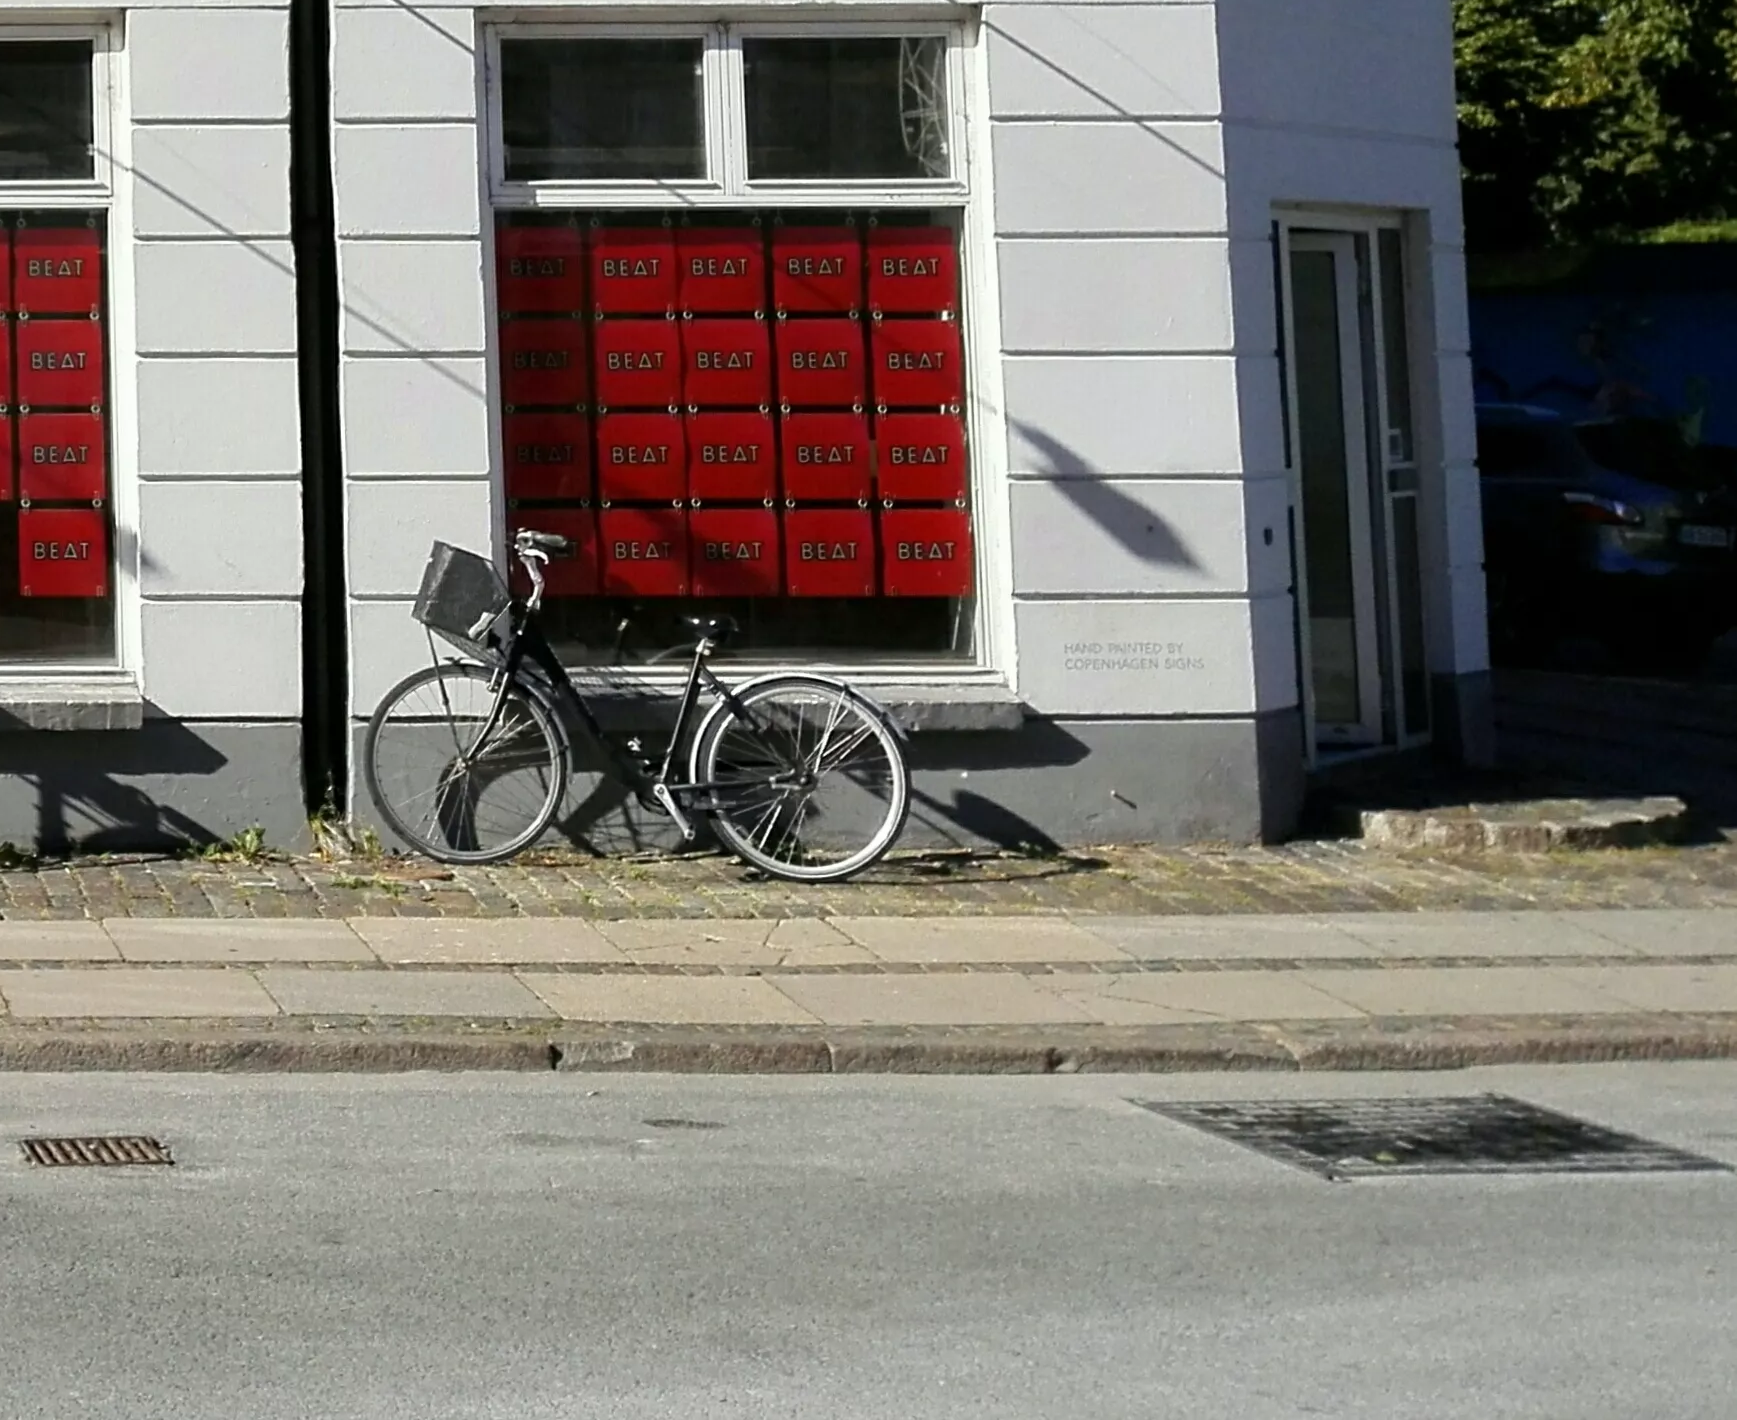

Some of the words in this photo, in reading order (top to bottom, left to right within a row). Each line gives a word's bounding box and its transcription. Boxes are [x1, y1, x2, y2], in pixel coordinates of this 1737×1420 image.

[29, 259, 83, 276] BEAT
[511, 259, 566, 275] BEAT
[604, 259, 659, 276] BEAT
[692, 259, 747, 276] BEAT
[788, 259, 844, 275] BEAT
[883, 259, 938, 276] BEAT
[32, 353, 86, 369] BEAT
[514, 352, 569, 368] BEAT
[608, 352, 663, 369] BEAT
[697, 352, 753, 369] BEAT
[793, 352, 847, 369] BEAT
[888, 352, 943, 369] BEAT
[34, 446, 88, 463] BEAT
[518, 445, 573, 462] BEAT
[613, 447, 668, 463] BEAT
[703, 446, 758, 462] BEAT
[798, 446, 853, 463] BEAT
[892, 447, 947, 463] BEAT
[35, 542, 89, 559] BEAT
[615, 542, 670, 559] BEAT
[706, 542, 762, 559] BEAT
[802, 543, 857, 560] BEAT
[899, 543, 954, 560] BEAT
[1064, 643, 1102, 654] HAND
[1108, 643, 1162, 654] PAINTED
[1167, 643, 1183, 654] BY
[1065, 658, 1159, 670] COPENHAGEN
[1165, 658, 1204, 670] SIGNS
